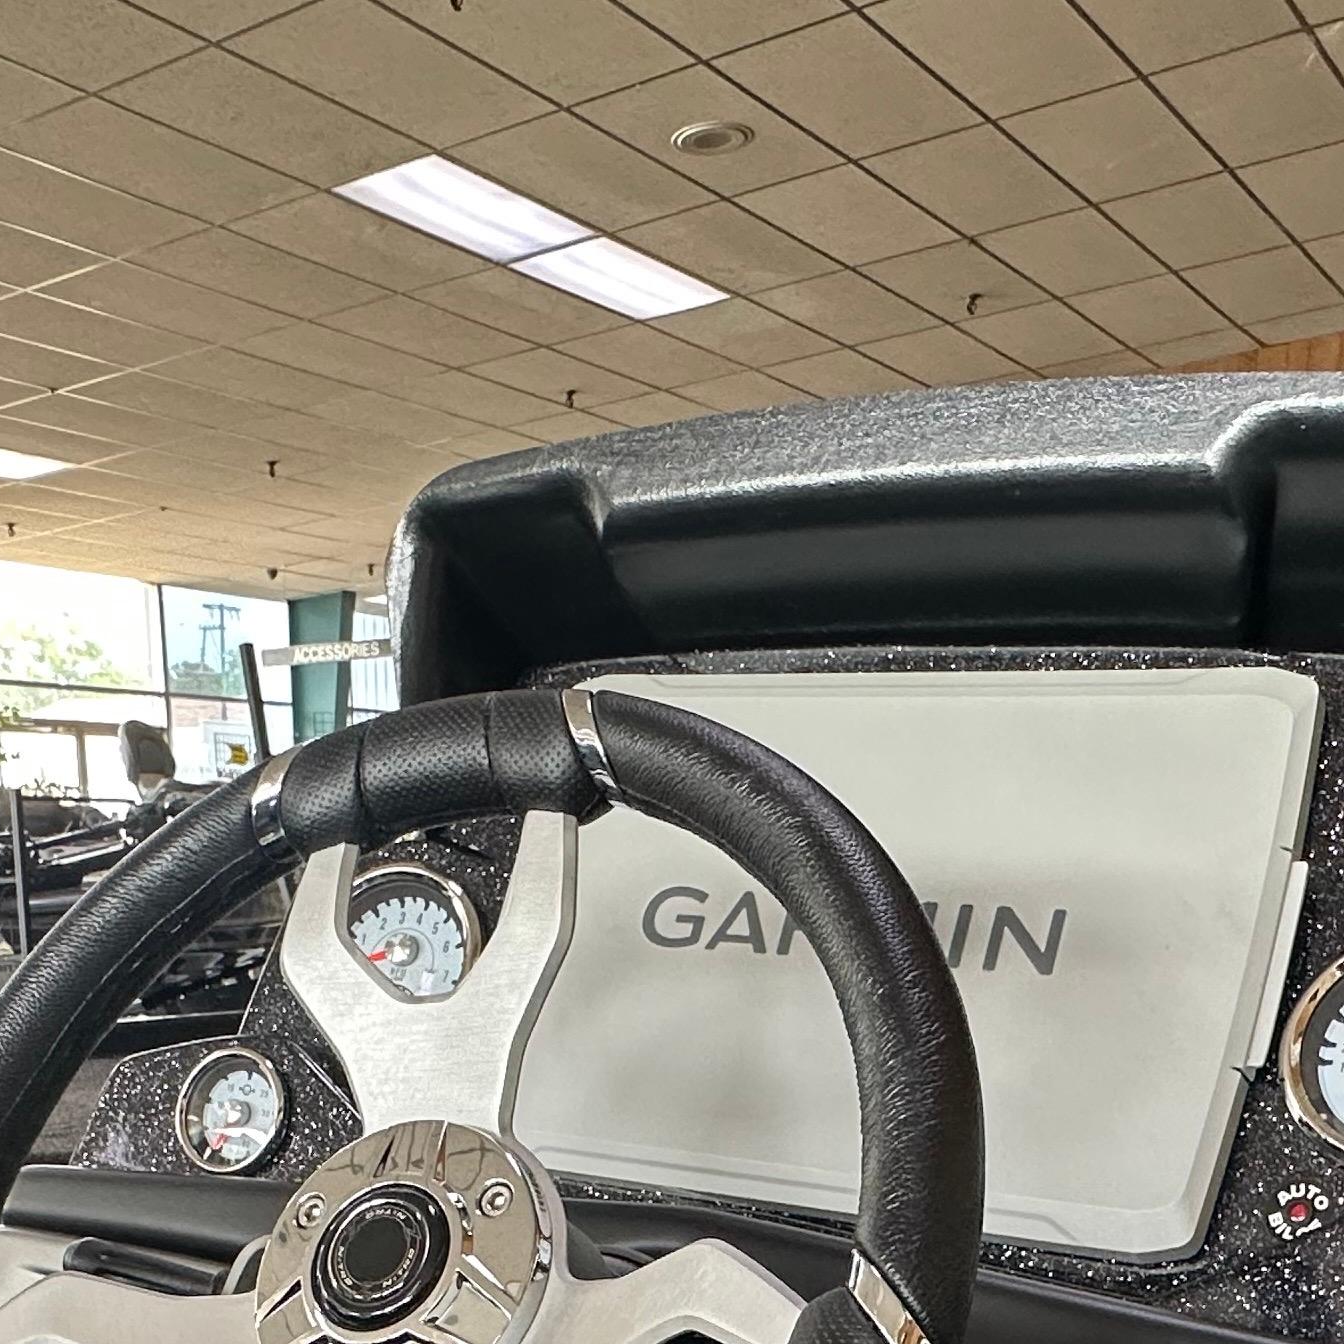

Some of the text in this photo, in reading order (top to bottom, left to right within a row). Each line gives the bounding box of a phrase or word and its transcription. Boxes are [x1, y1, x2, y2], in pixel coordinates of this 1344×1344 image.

[293, 641, 379, 661] ACCESSORIES
[380, 917, 388, 930] 2
[399, 912, 406, 925] 3
[417, 912, 424, 926] 4
[431, 922, 440, 935] 5
[642, 886, 1067, 975] GAIN
[443, 940, 451, 954] 6
[1277, 1182, 1329, 1211] AUTO
